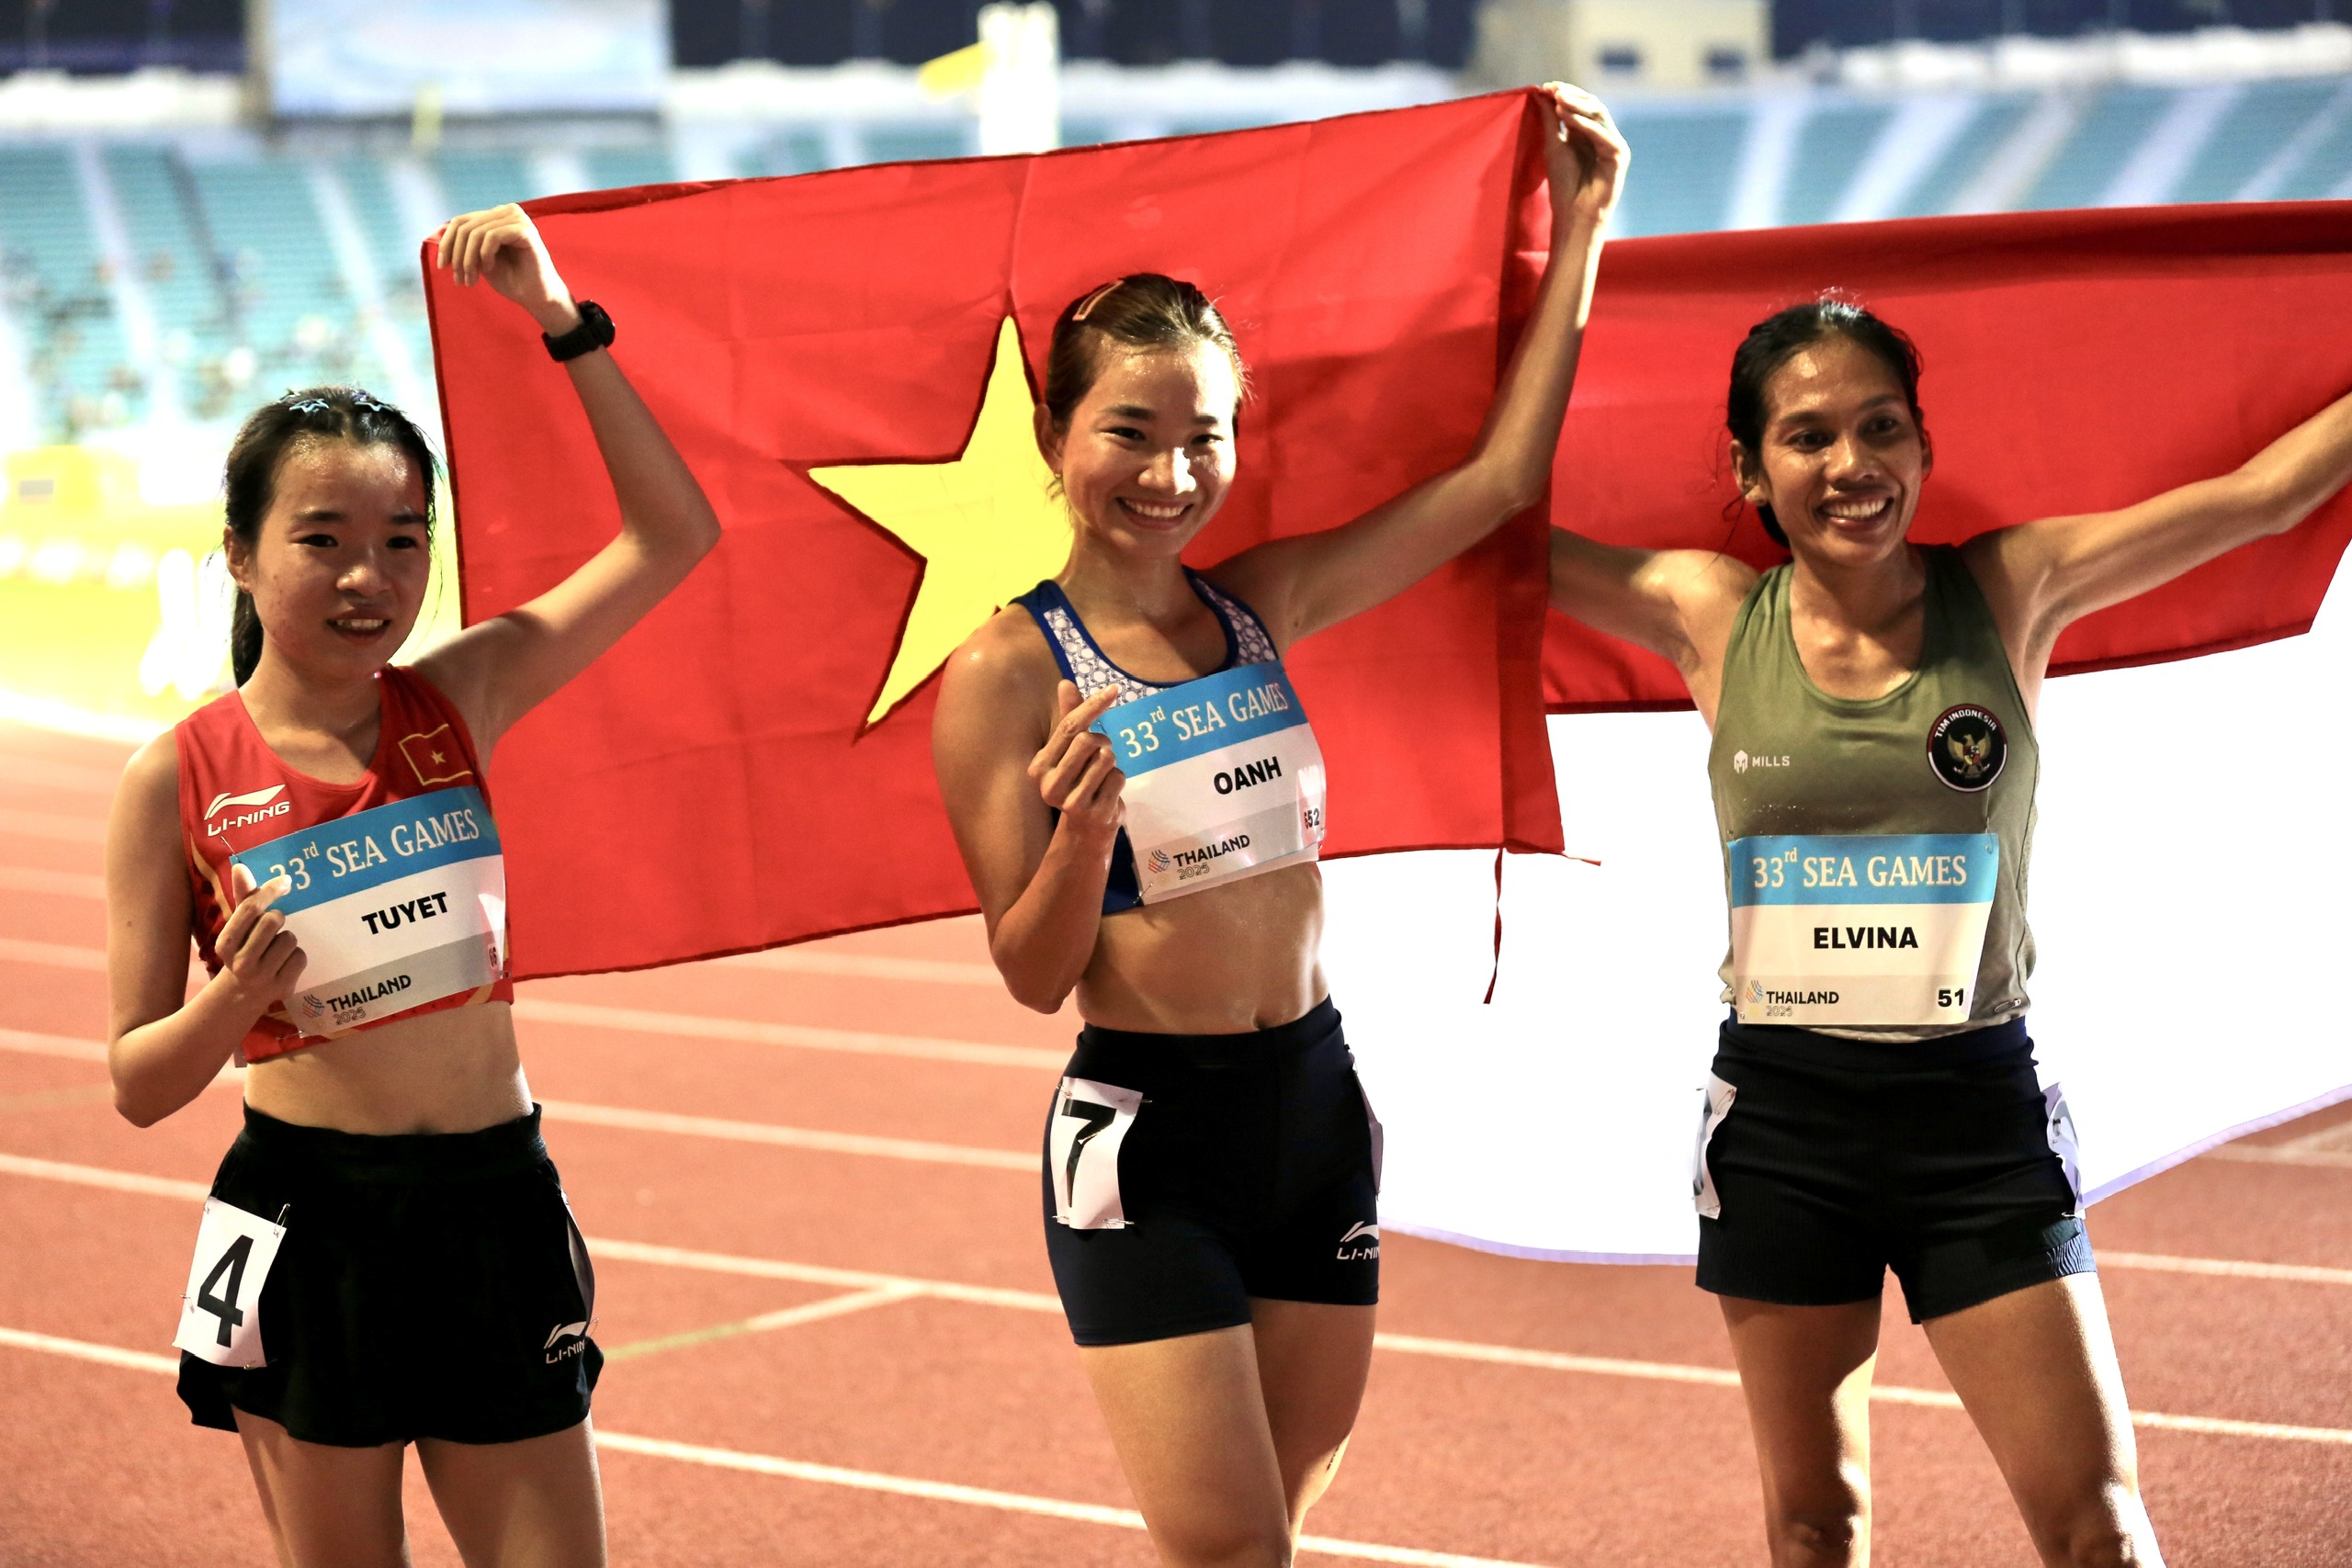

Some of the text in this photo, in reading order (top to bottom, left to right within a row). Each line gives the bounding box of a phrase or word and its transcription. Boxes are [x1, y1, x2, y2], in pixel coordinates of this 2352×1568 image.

[1172, 701, 1227, 741] SEA
[1227, 682, 1289, 723] GAMES
[1935, 708, 1997, 738] TIM INDONESIA
[1213, 756, 1283, 795] OANH
[1752, 755, 1790, 767] MILLS
[207, 801, 290, 837] LI-NING
[326, 836, 387, 877] SEA
[390, 808, 480, 858] GAMES
[1172, 834, 1250, 867] THAILAND
[1177, 863, 1210, 881] 2025
[1752, 848, 1967, 888] 33rd SEA GAMES
[361, 892, 448, 935] TUYET
[1813, 927, 1919, 949] ELVINA
[326, 974, 412, 1012] THAILAND
[1766, 991, 1839, 1004] THAILAND
[1937, 988, 1965, 1008] 51
[333, 1006, 367, 1025] 2025
[1766, 1005, 1793, 1017] 2025
[1061, 1099, 1117, 1208] 7
[198, 1235, 254, 1348] 4
[546, 1339, 585, 1364] LI-NIN
